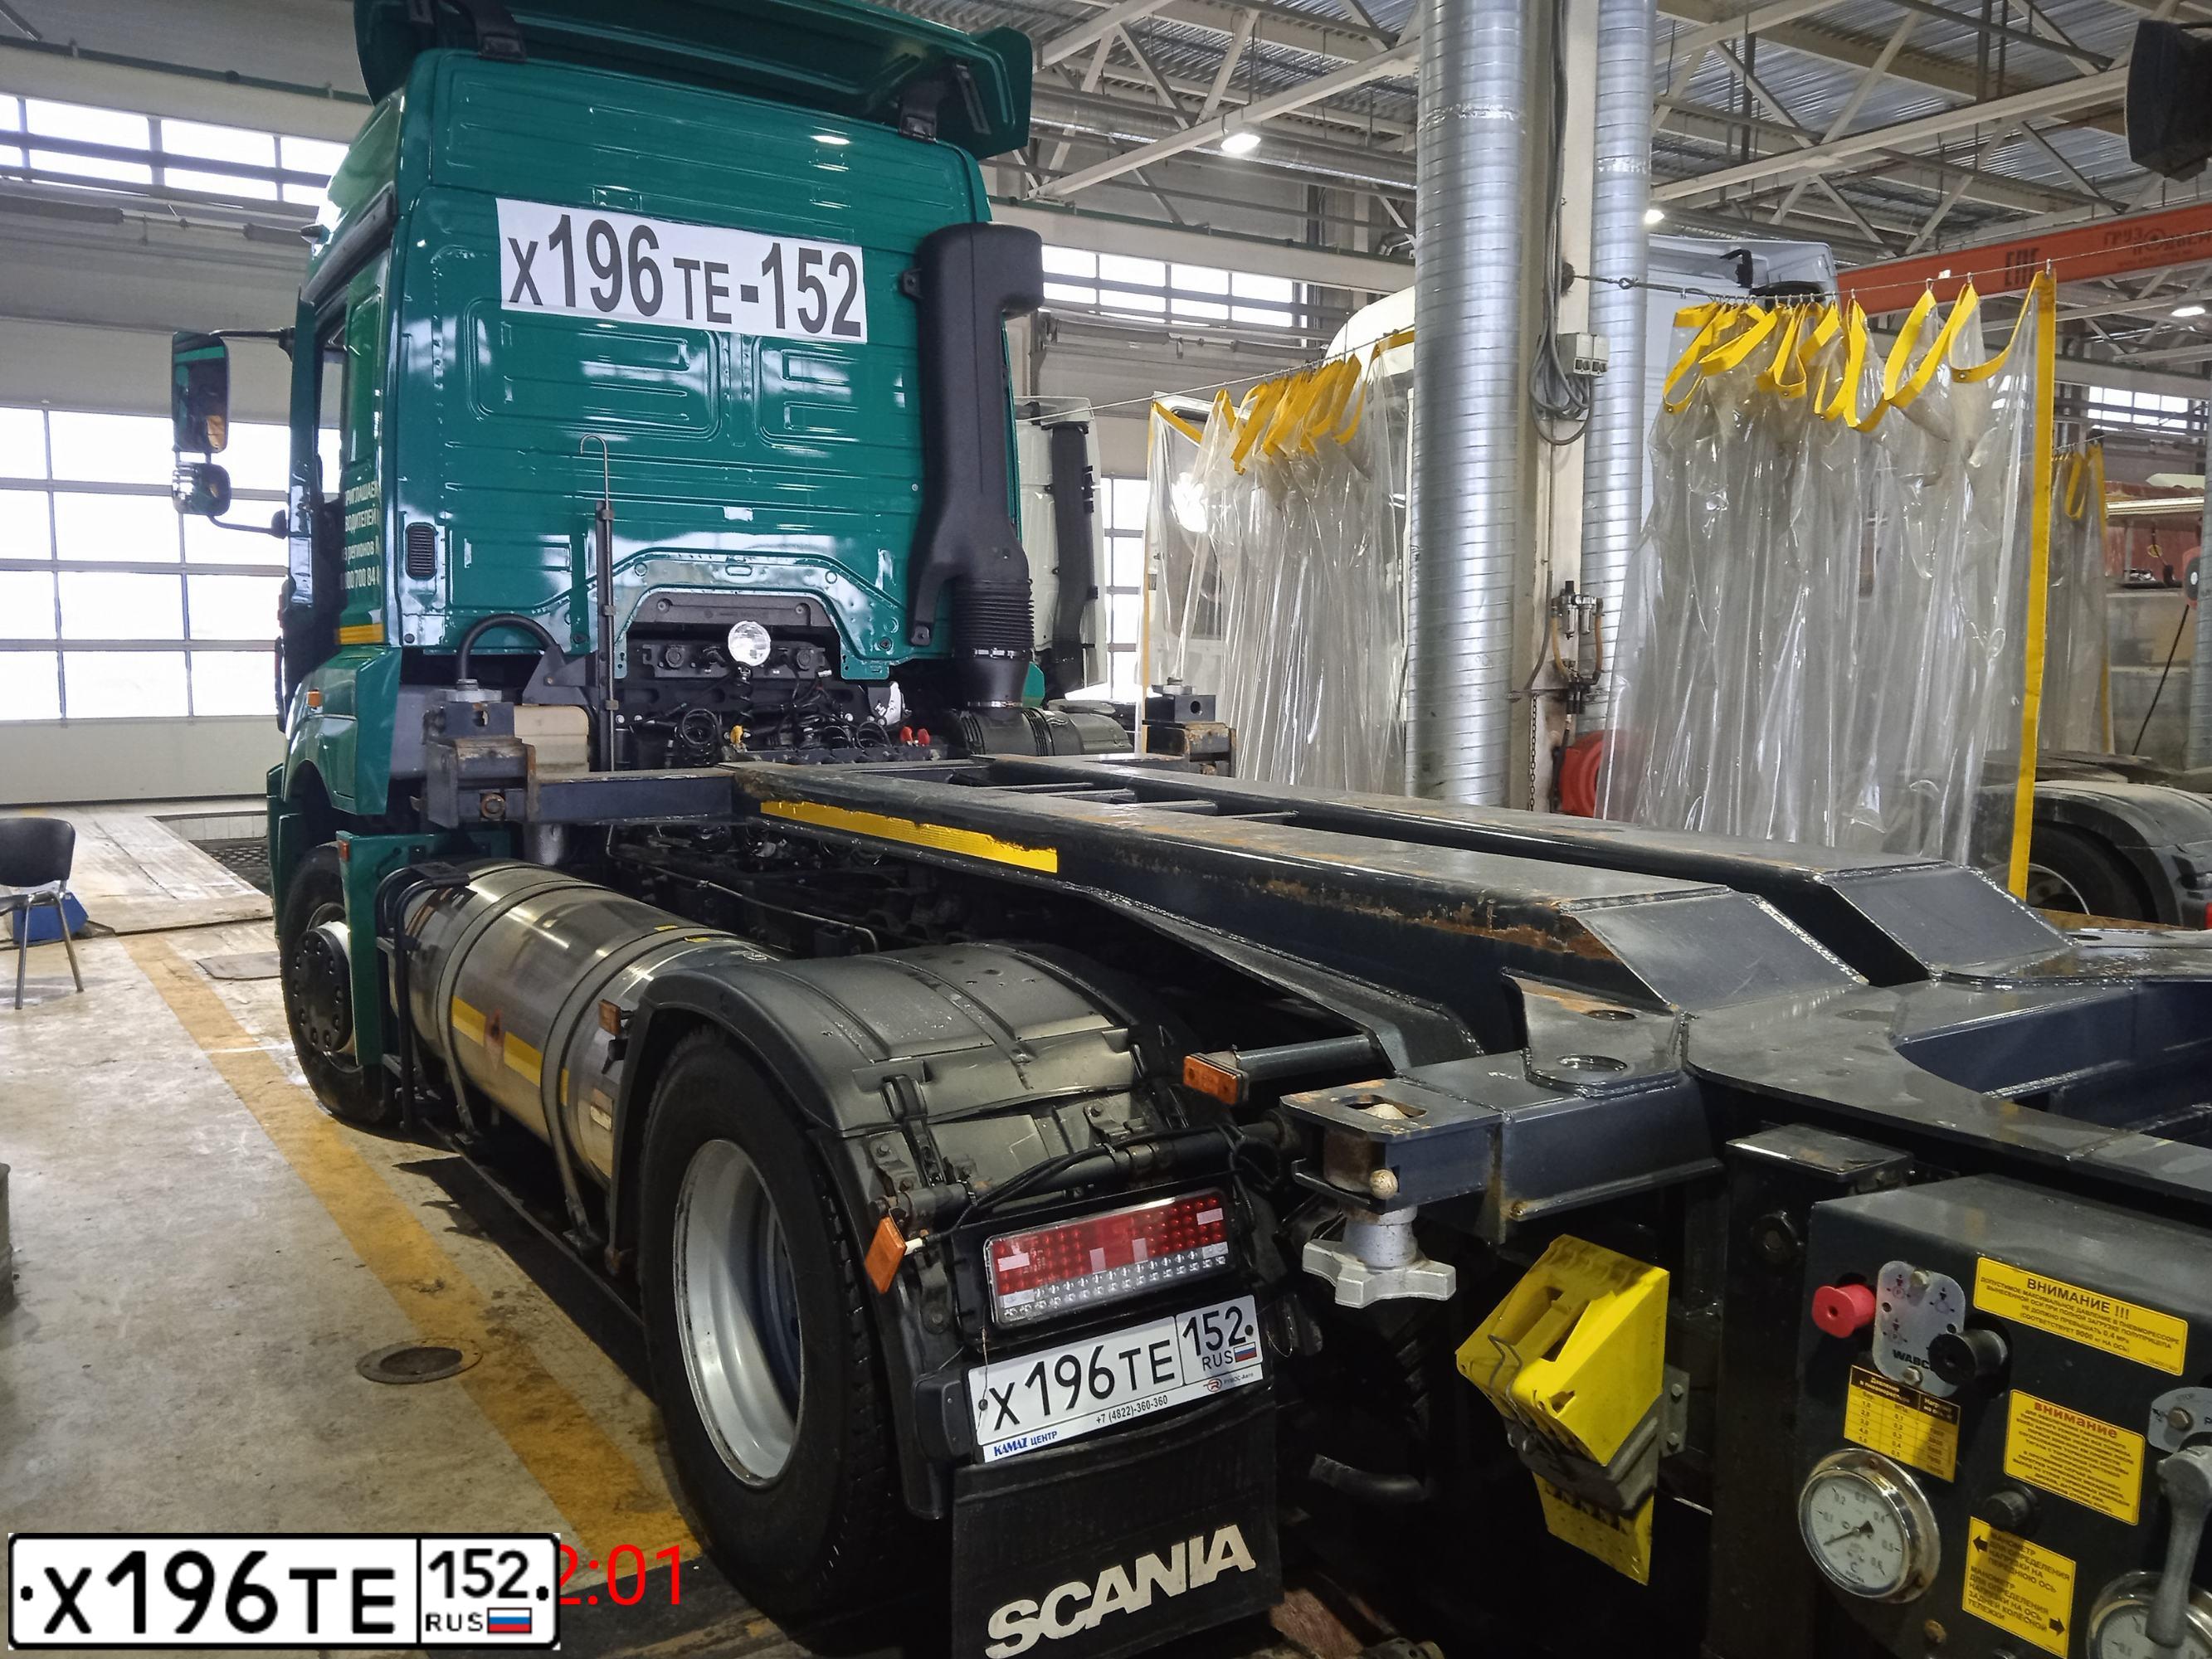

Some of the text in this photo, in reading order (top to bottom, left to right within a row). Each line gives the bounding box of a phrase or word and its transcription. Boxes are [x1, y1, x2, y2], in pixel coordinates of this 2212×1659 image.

[2025, 1277, 2130, 1321] ВНИМАНИЕ !!!
[1182, 1306, 1246, 1357] 152
[1202, 1350, 1234, 1371] RUS
[1892, 1349, 1930, 1370] WABC
[1108, 1394, 1168, 1423] (4822)-360-360
[2034, 1400, 2117, 1440] внимание
[1030, 1430, 1058, 1447] ЦЕНТР
[2030, 1566, 2044, 1579] НА
[985, 1524, 1257, 1659] SCANIA
[2038, 1579, 2057, 1593] ОСЬ
[2024, 1606, 2042, 1621] ОСЬ
